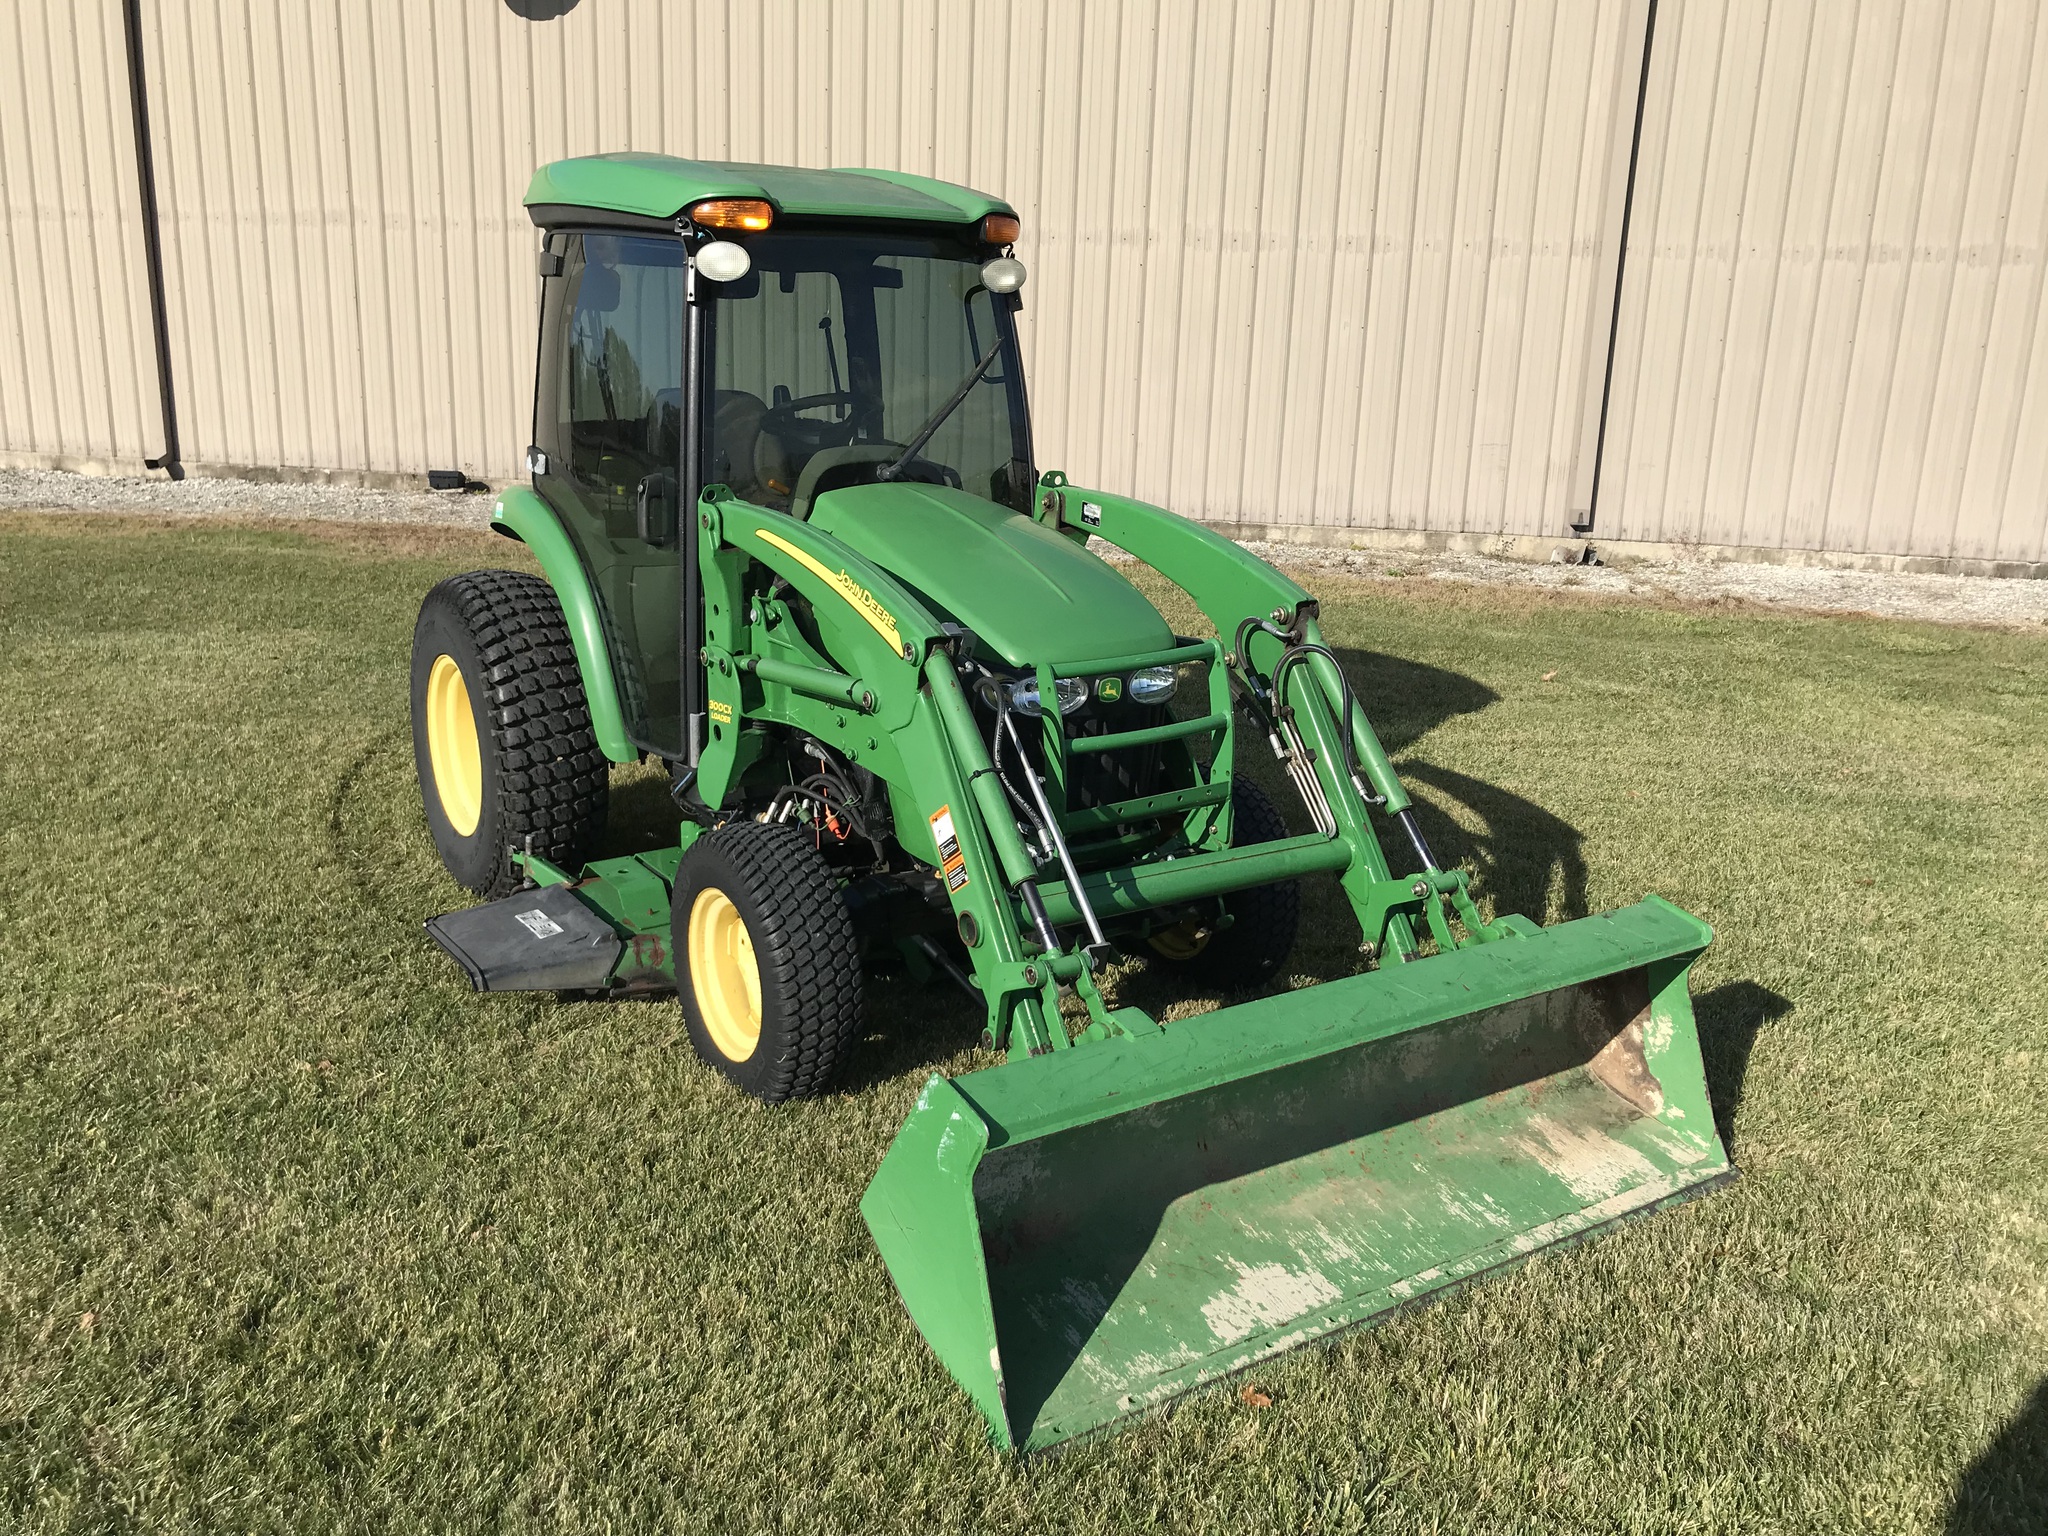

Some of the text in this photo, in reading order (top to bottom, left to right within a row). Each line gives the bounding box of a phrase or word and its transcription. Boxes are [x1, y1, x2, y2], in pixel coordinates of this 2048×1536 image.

[836, 569, 897, 631] JOHN DEERE
[709, 700, 733, 715] 300CX
[711, 712, 731, 724] LOADER
